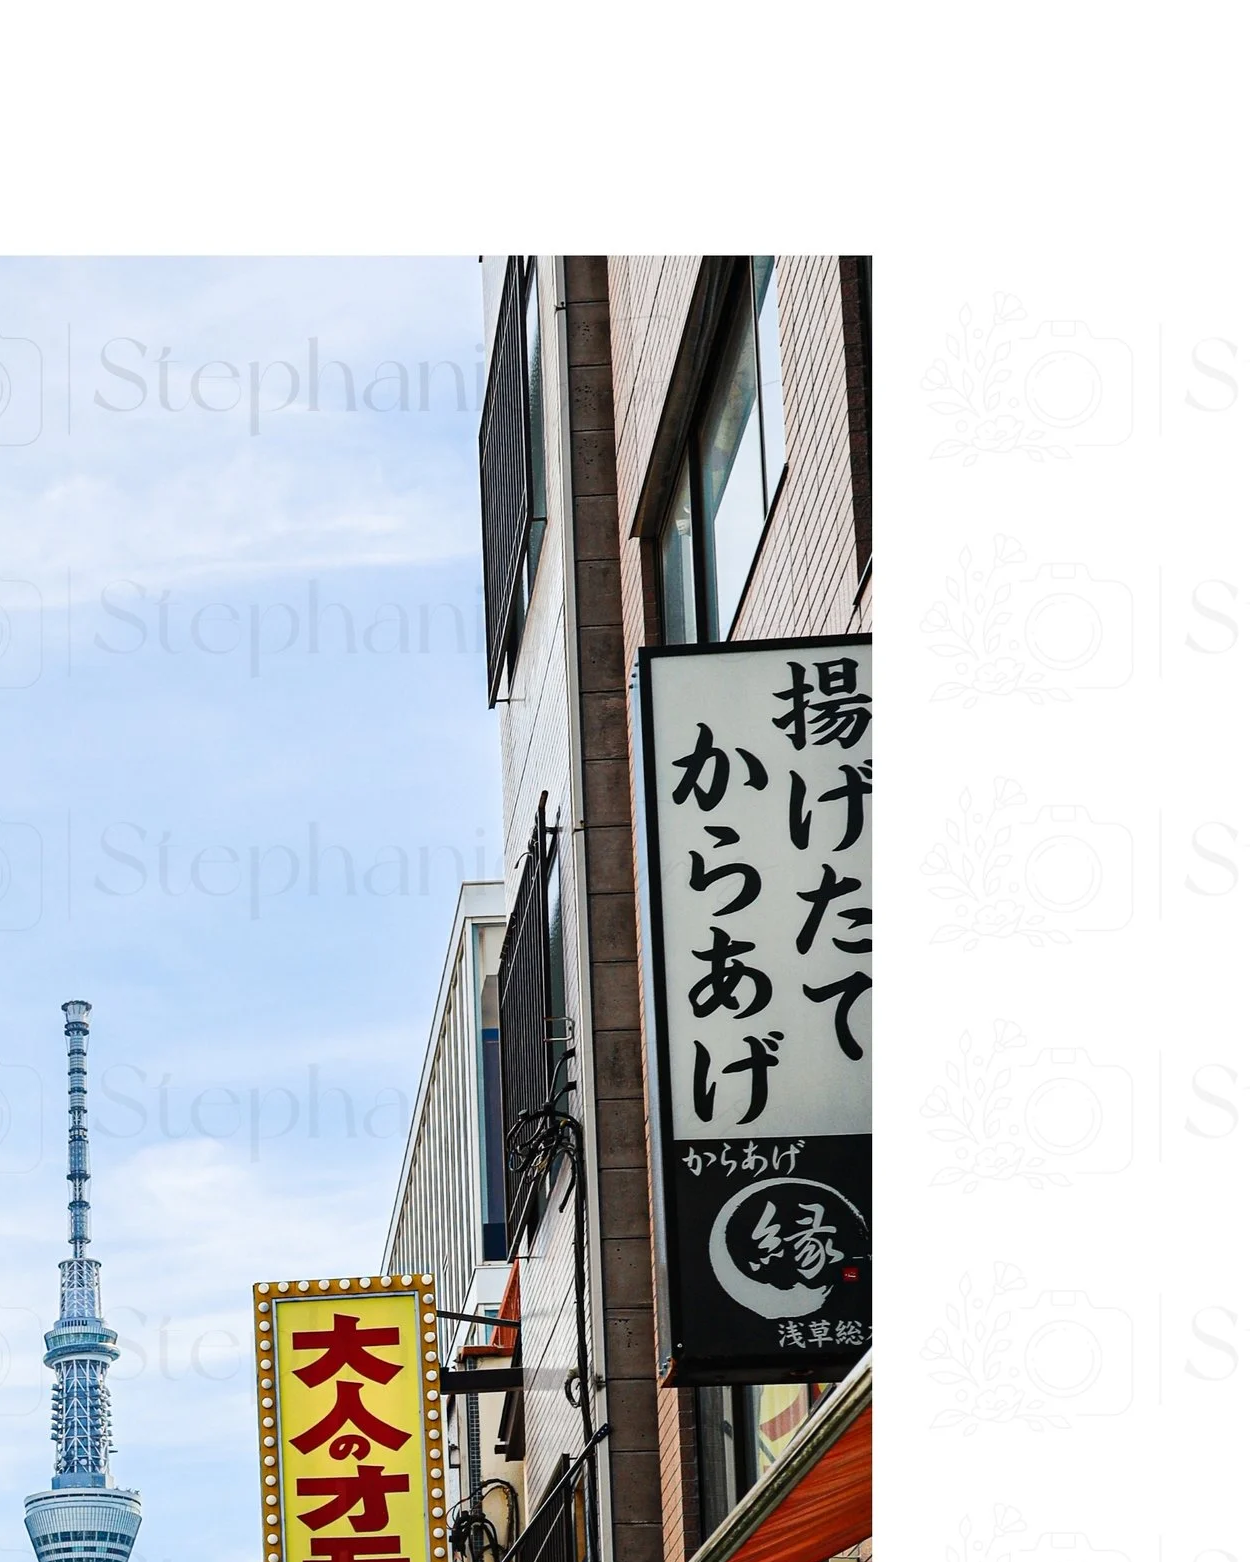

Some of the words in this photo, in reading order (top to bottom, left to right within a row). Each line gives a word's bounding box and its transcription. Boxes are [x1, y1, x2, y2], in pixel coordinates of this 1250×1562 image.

[671, 722, 785, 1126] からあげ
[772, 660, 872, 1060] 揚げたて
[682, 1140, 805, 1178] からあげ
